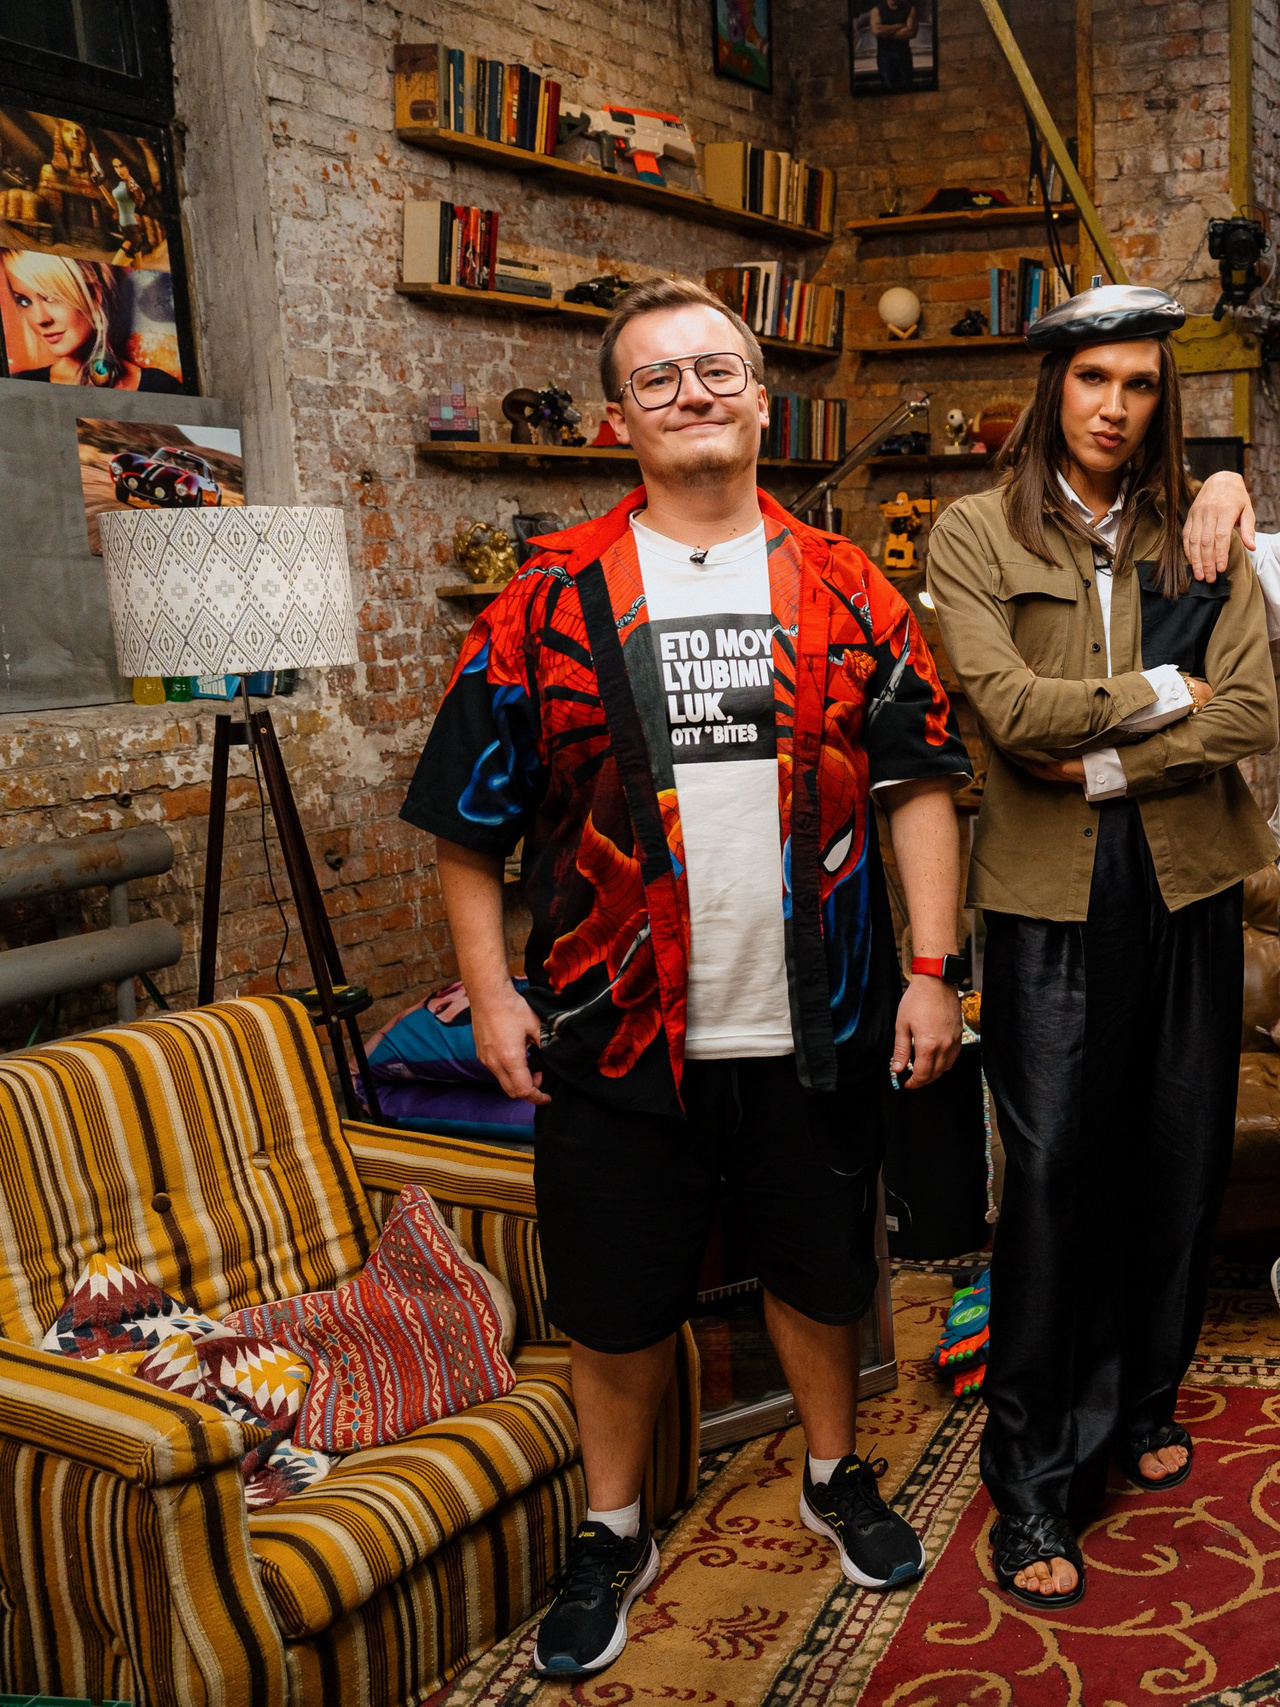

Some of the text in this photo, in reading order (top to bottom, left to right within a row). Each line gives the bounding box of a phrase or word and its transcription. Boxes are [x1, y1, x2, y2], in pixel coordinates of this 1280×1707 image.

[660, 628, 773, 660] ETO MOY
[667, 692, 734, 724] LUK,
[671, 727, 702, 746] OTY
